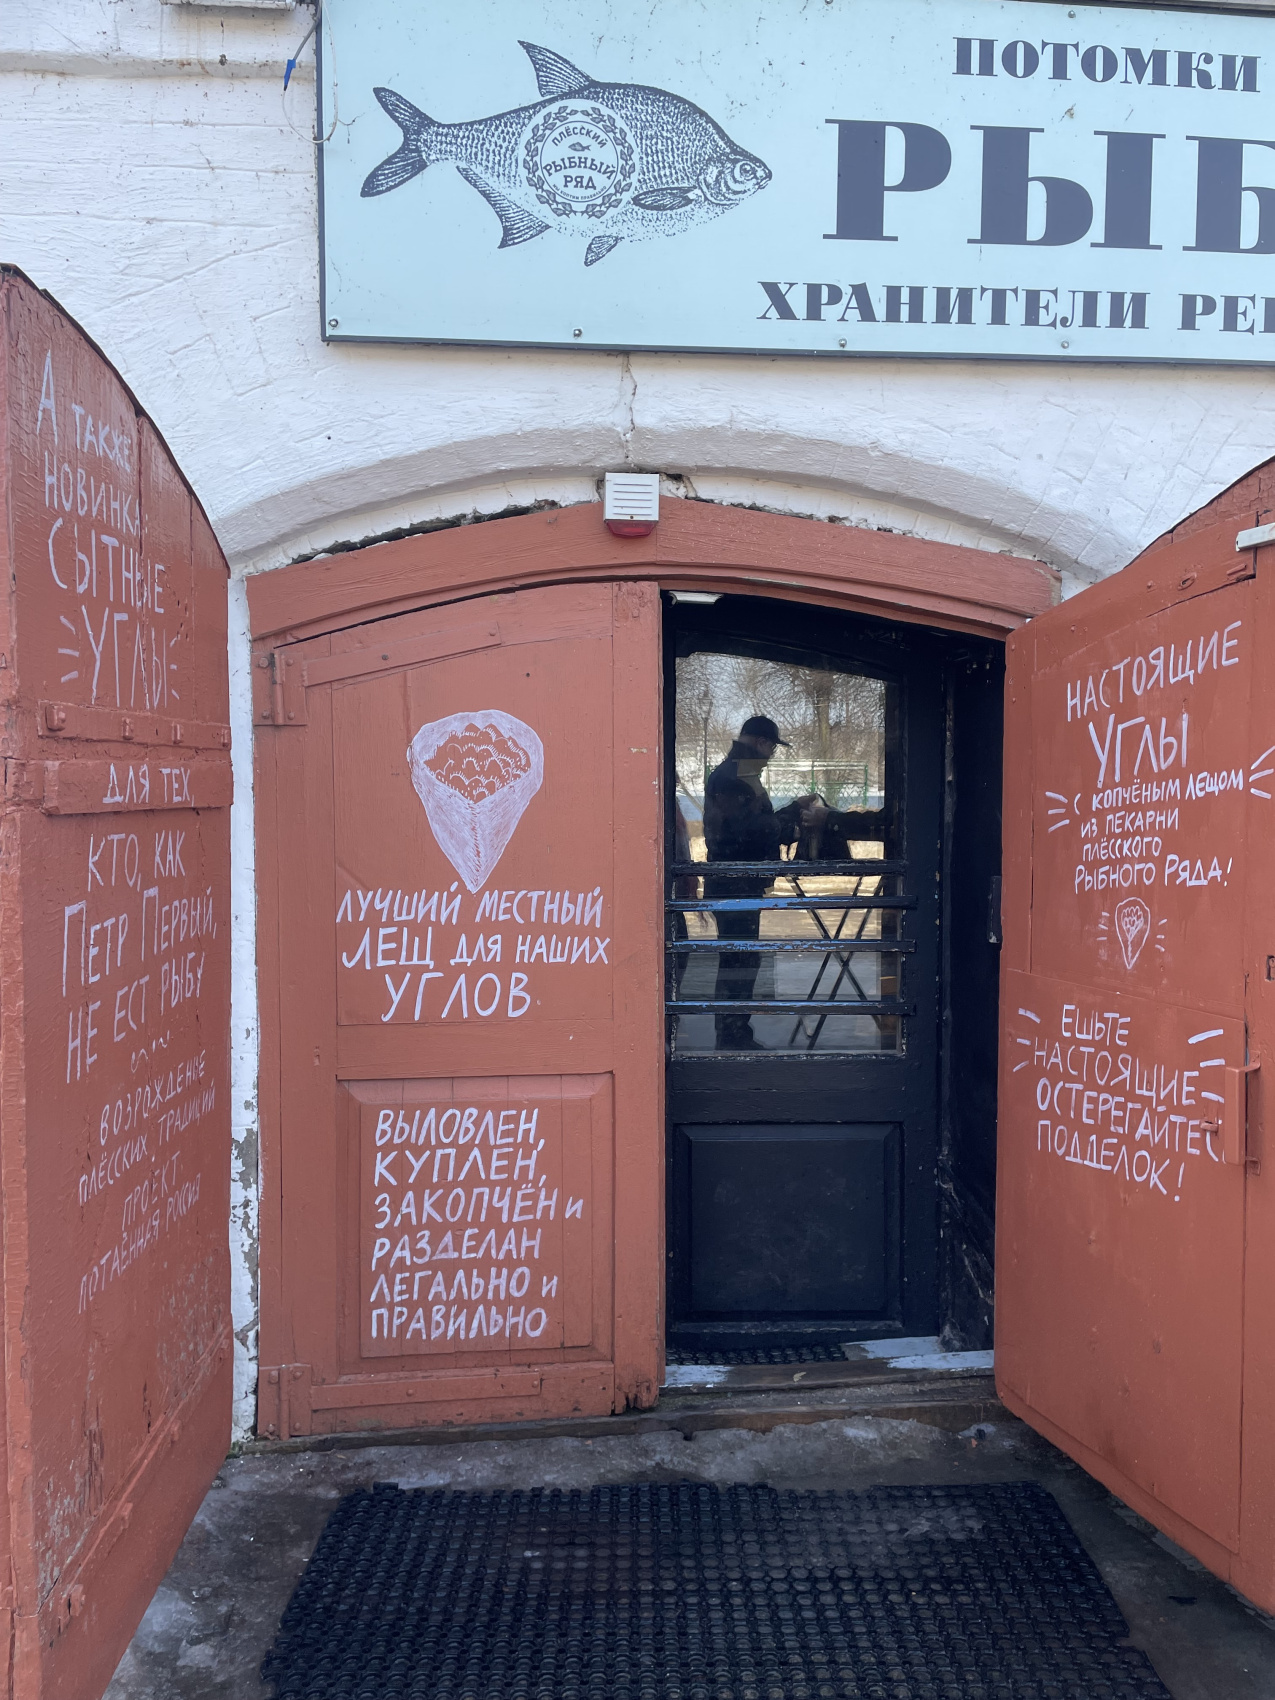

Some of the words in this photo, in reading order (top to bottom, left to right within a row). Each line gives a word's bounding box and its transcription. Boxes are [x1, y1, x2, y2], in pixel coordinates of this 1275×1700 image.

[952, 36, 1261, 92] ПОТОМКИ
[551, 125, 609, 149] ПЛЁССКИЙ
[542, 156, 616, 181] РЫБНЫЙ
[563, 174, 597, 191] РЯД
[560, 190, 580, 200] КОПТИМ
[756, 281, 1151, 330] ХРАНИТЕЛИ
[36, 349, 58, 446] А
[71, 402, 132, 473] ТАКЖЕ
[44, 450, 149, 538] НОВИНКА:
[48, 517, 165, 614] СЫТНЫЕ
[81, 604, 168, 710] УГЛЫ
[1066, 620, 1242, 723] НАСТОЯЩИЕ
[1088, 711, 1189, 789] УГЛЫ
[102, 762, 150, 804] ДЛЯ
[159, 766, 195, 807] ТЕХ,
[1073, 792, 1082, 815] С
[1091, 778, 1181, 812] КОПЧЁНЫМ
[1185, 768, 1244, 801] ЛЕЩОМ
[1081, 816, 1098, 839] ИЗ
[1105, 807, 1179, 836] ПЕКАРНИ
[87, 832, 142, 892] КТО,
[154, 829, 186, 879] КАК
[1082, 835, 1162, 863] ПЛЁССКОГО
[335, 880, 463, 926] ЛУЧШИЙ
[474, 885, 604, 929] МЕСТНЫЙ
[341, 925, 435, 970] ЛЕЩ
[449, 932, 502, 967] ДЛЯ
[515, 933, 611, 965] НАШИХ
[66, 999, 101, 1085] НЕ
[113, 974, 150, 1043] ЕСТ
[160, 951, 205, 1016] РЫБУ
[380, 971, 532, 1022] УГЛОВ
[1061, 1003, 1131, 1047] ЕШЬТЕ
[1034, 1036, 1200, 1109] НАСТОЯЩИЕ
[100, 1049, 206, 1147] ВОЗРОЖДЕНИЕ
[1036, 1077, 1226, 1164] ОСТЕРЕГАЙТЕС
[79, 1133, 148, 1207] ПЛЁССКИХ
[157, 1077, 216, 1147] ТРАДИЦИЙ
[374, 1107, 546, 1151] ВЫЛОВЛЕН,
[121, 1150, 181, 1232] ПРОЕКТ
[374, 1147, 547, 1188] КУПЛЕН,
[165, 1172, 201, 1232] РОССИЯ
[374, 1183, 559, 1230] ЗАКОПЧЁН
[371, 1227, 542, 1272] РАЗДЕЛАН
[369, 1266, 532, 1303] ЛЕГАЛЬНО
[371, 1303, 549, 1341] ПРАВИЛЬНО
